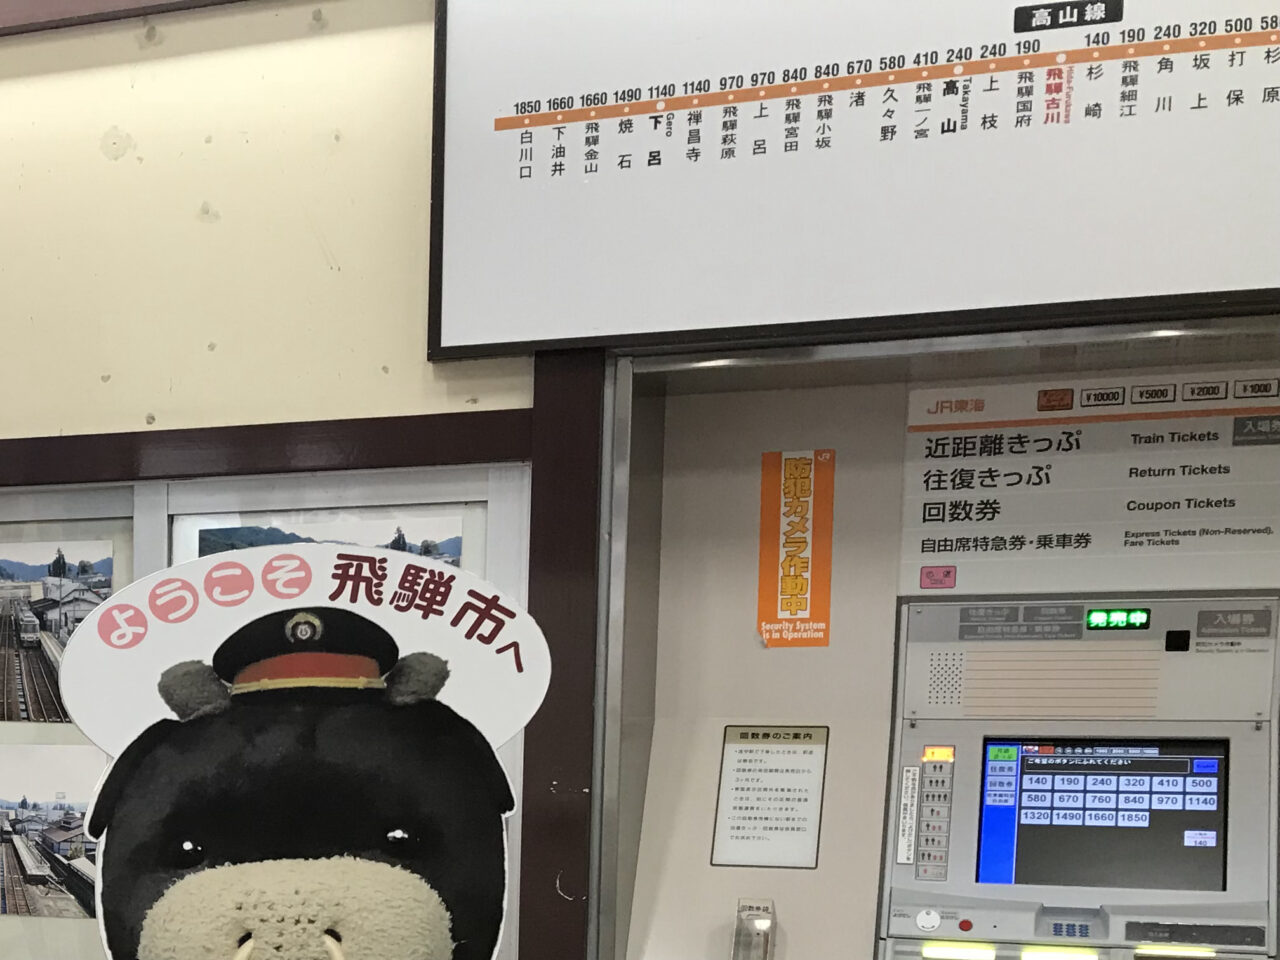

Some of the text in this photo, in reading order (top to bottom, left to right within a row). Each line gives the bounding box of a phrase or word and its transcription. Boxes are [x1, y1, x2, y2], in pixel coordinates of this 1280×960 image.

[1032, 2, 1106, 27] 高山線
[514, 14, 1280, 115] 1850 1660 1660 1490 1140 1140 970 970 840 840 670 580 410 240 240 190 140 190 240 320 500 58
[1084, 64, 1104, 119] 杉崎
[1155, 56, 1174, 113] 角川
[1190, 53, 1211, 111] 坂上
[1226, 51, 1246, 107] 打保
[849, 91, 866, 108] 渚
[941, 79, 960, 134] 高山
[960, 76, 972, 131] Takayama
[981, 76, 999, 130] 上枝
[665, 112, 675, 137] Gero
[880, 87, 898, 142] 久々野
[647, 115, 664, 167] 下呂
[686, 110, 702, 162] 禅昌寺
[752, 102, 769, 155] 上呂
[519, 130, 533, 179] 白川口
[551, 127, 566, 177] 下油井
[618, 119, 634, 169] 焼石
[927, 398, 986, 415] JR東海
[925, 431, 1082, 459] 近距離きっぷ
[1131, 431, 1219, 444] Train Tickets
[923, 464, 1052, 491] 往復きっぷ
[1129, 464, 1231, 478] Return Tickets
[922, 499, 1001, 523] 回数券
[1127, 498, 1236, 512] Coupon Tickets
[780, 457, 812, 615] 防犯カメラ作動中
[921, 533, 1092, 554] 自由席特急券・乗車券
[1124, 530, 1160, 539] Express
[1164, 528, 1197, 537] Tickets
[1124, 538, 1180, 547] Fare Tickets
[100, 556, 310, 648] ようこそ
[761, 620, 826, 632] Security System
[1088, 610, 1149, 627] 発売中
[782, 629, 824, 640] Operation
[1028, 777, 1047, 785] 140
[1061, 777, 1080, 785] 190
[1092, 778, 1112, 786] 240
[1158, 779, 1178, 787] 410
[1192, 779, 1212, 787] 500
[1027, 794, 1046, 802] 580
[1059, 794, 1078, 803] 670
[1091, 795, 1111, 803] 760
[1124, 796, 1144, 804] 840
[1157, 797, 1177, 805] 970
[1023, 811, 1148, 822] 1320 1490 1660 1850
